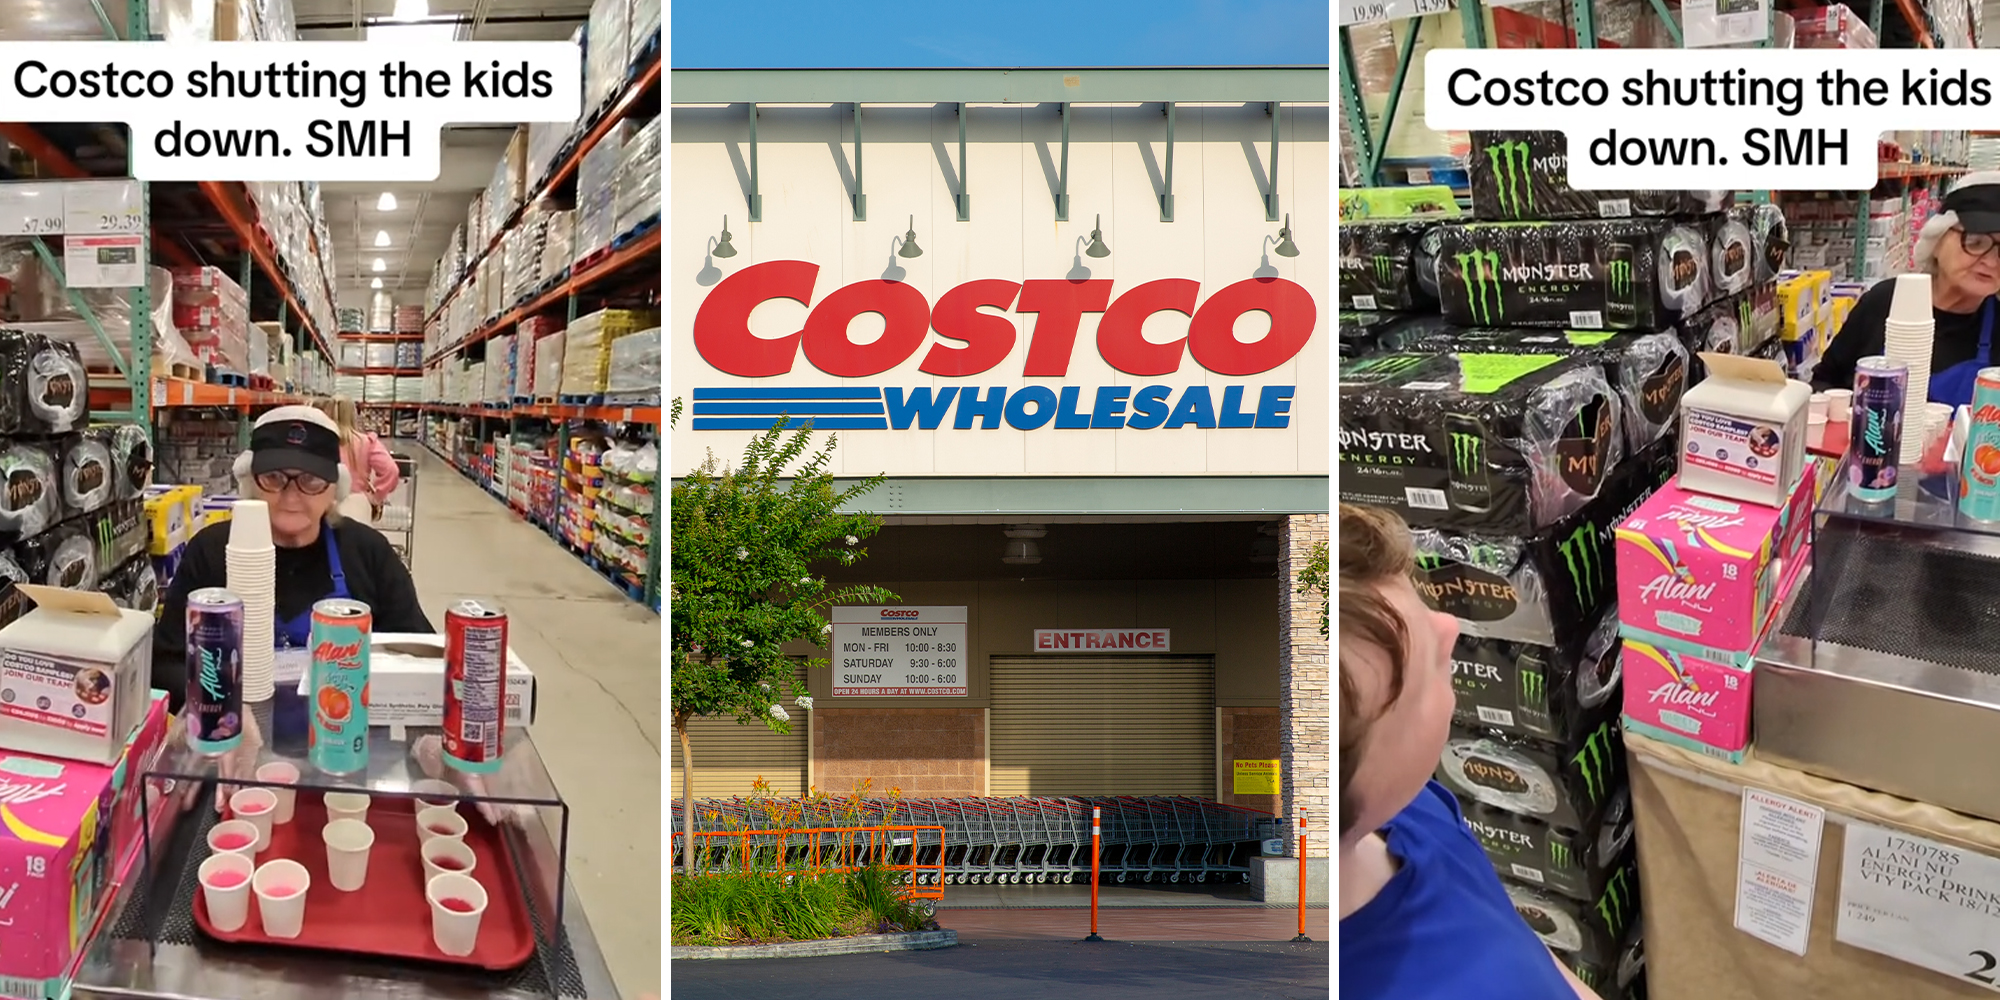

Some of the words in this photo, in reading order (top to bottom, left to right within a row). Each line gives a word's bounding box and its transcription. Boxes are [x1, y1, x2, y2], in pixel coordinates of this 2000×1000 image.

[1352, 4, 1384, 21] 19.99
[100, 214, 141, 230] 29.39
[1502, 262, 1593, 284] MONSTER
[1518, 284, 1582, 294] ENERGY
[693, 260, 1318, 378] COSTCO
[883, 385, 1297, 430] WHOLESALE
[1700, 414, 1714, 422] YOU
[1715, 418, 1732, 426] LOVE
[1690, 425, 1706, 434] JOIN
[1707, 429, 1723, 437] OUR
[1722, 563, 1738, 576] 18
[1412, 577, 1518, 601] MONSTER
[1638, 575, 1716, 605] Alani
[881, 609, 919, 617] COSTCO
[1681, 600, 1713, 613] NU
[862, 627, 910, 637] MEMBERS
[913, 627, 938, 637] ONLY
[843, 643, 866, 652] MON
[874, 643, 889, 652] FRI
[905, 643, 930, 652] 10:00
[937, 643, 957, 652] 8:30
[1038, 632, 1166, 649] ENTRANCE
[18, 656, 33, 664] YOU
[35, 659, 55, 668] LOVE
[843, 659, 894, 668] SATURDAY
[910, 659, 930, 668] 9:30
[937, 659, 957, 668] 6:00
[4, 669, 24, 678] JOIN
[26, 673, 44, 682] OUR
[843, 674, 882, 684] SUNDAY
[905, 674, 930, 684] 10:00
[937, 674, 957, 684] 6:00
[1723, 674, 1738, 687] 18
[1647, 682, 1720, 706] Alani
[1687, 704, 1717, 717] NU
[1751, 794, 1787, 809] ALLERGY
[1788, 805, 1817, 819] ALERT!
[1887, 836, 1961, 866] 1730785
[26, 855, 45, 872] 18
[1862, 846, 1919, 868] ALANI
[1925, 862, 1953, 877] NU
[1861, 858, 1935, 885] ENERGY
[1941, 879, 2000, 906] DRINK
[1861, 869, 1896, 887] VTY
[1902, 879, 1950, 903] PACK
